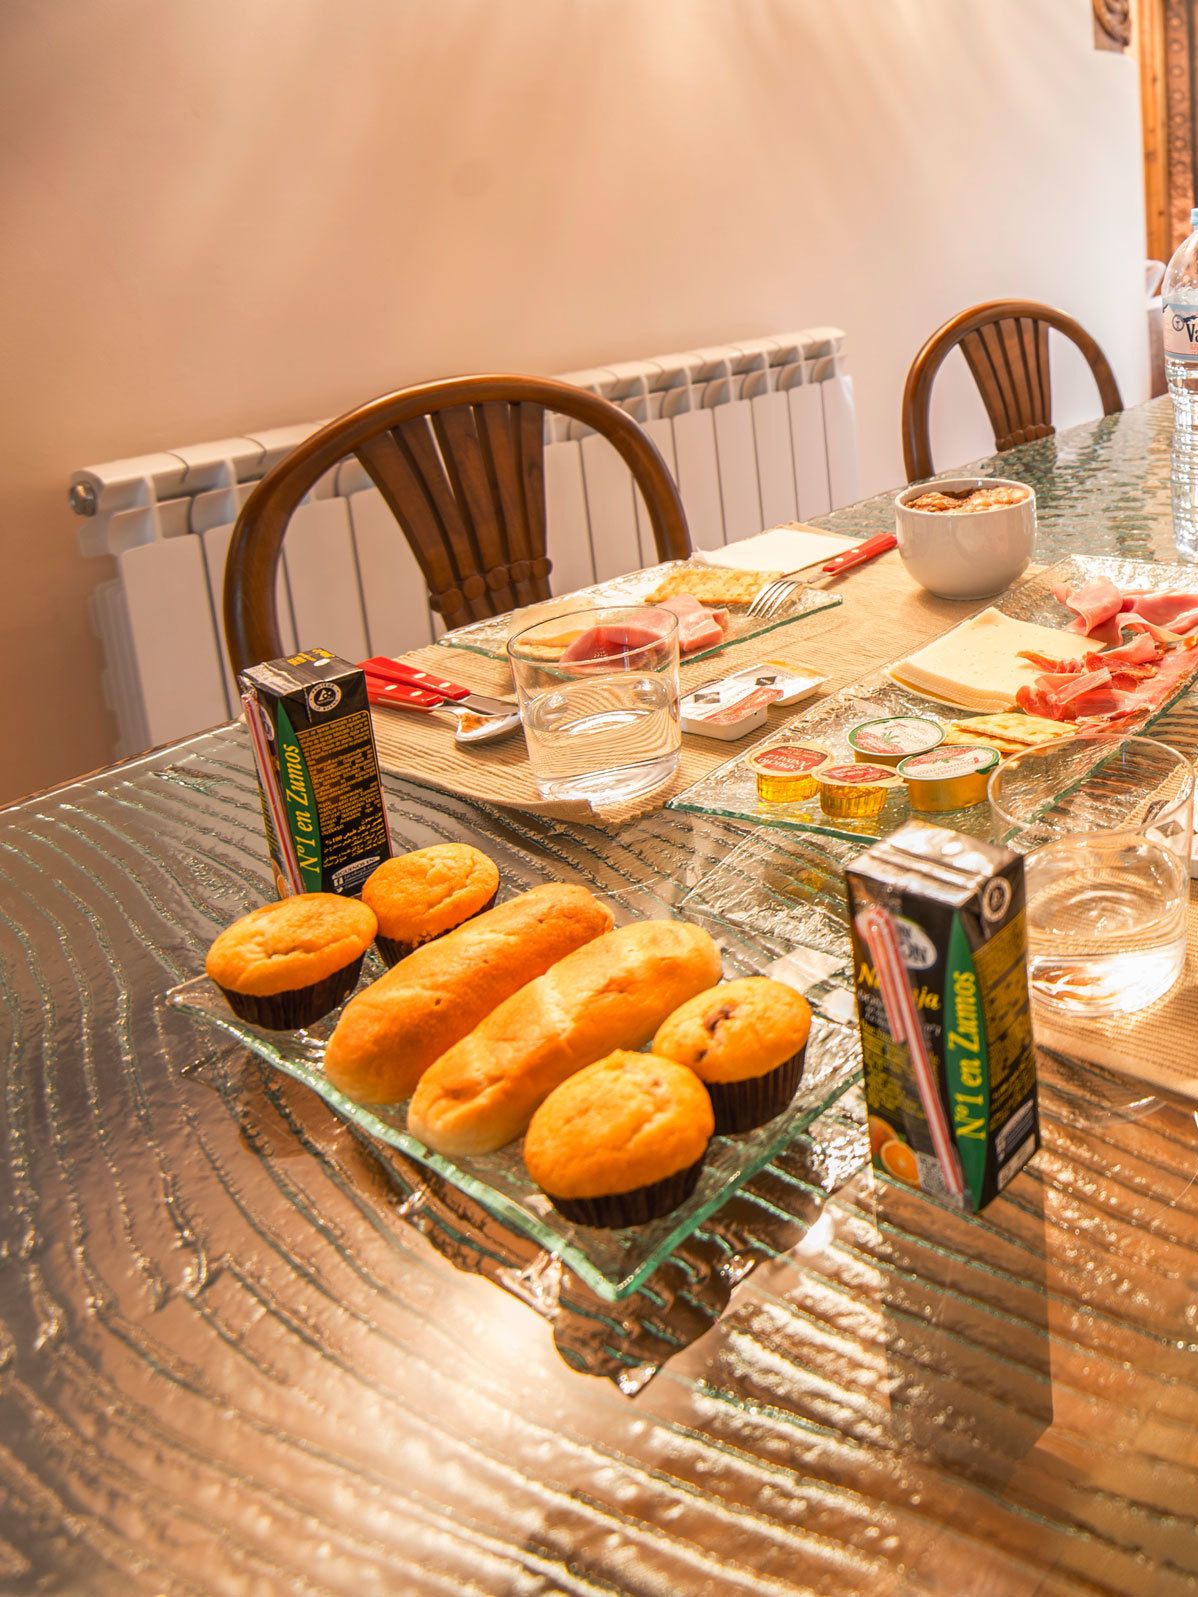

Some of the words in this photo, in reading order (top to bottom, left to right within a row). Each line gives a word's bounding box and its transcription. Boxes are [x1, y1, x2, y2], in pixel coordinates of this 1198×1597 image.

[282, 743, 309, 807] Zumos
[294, 810, 314, 833] en
[947, 970, 981, 1054] Zumos
[959, 1057, 984, 1089] en
